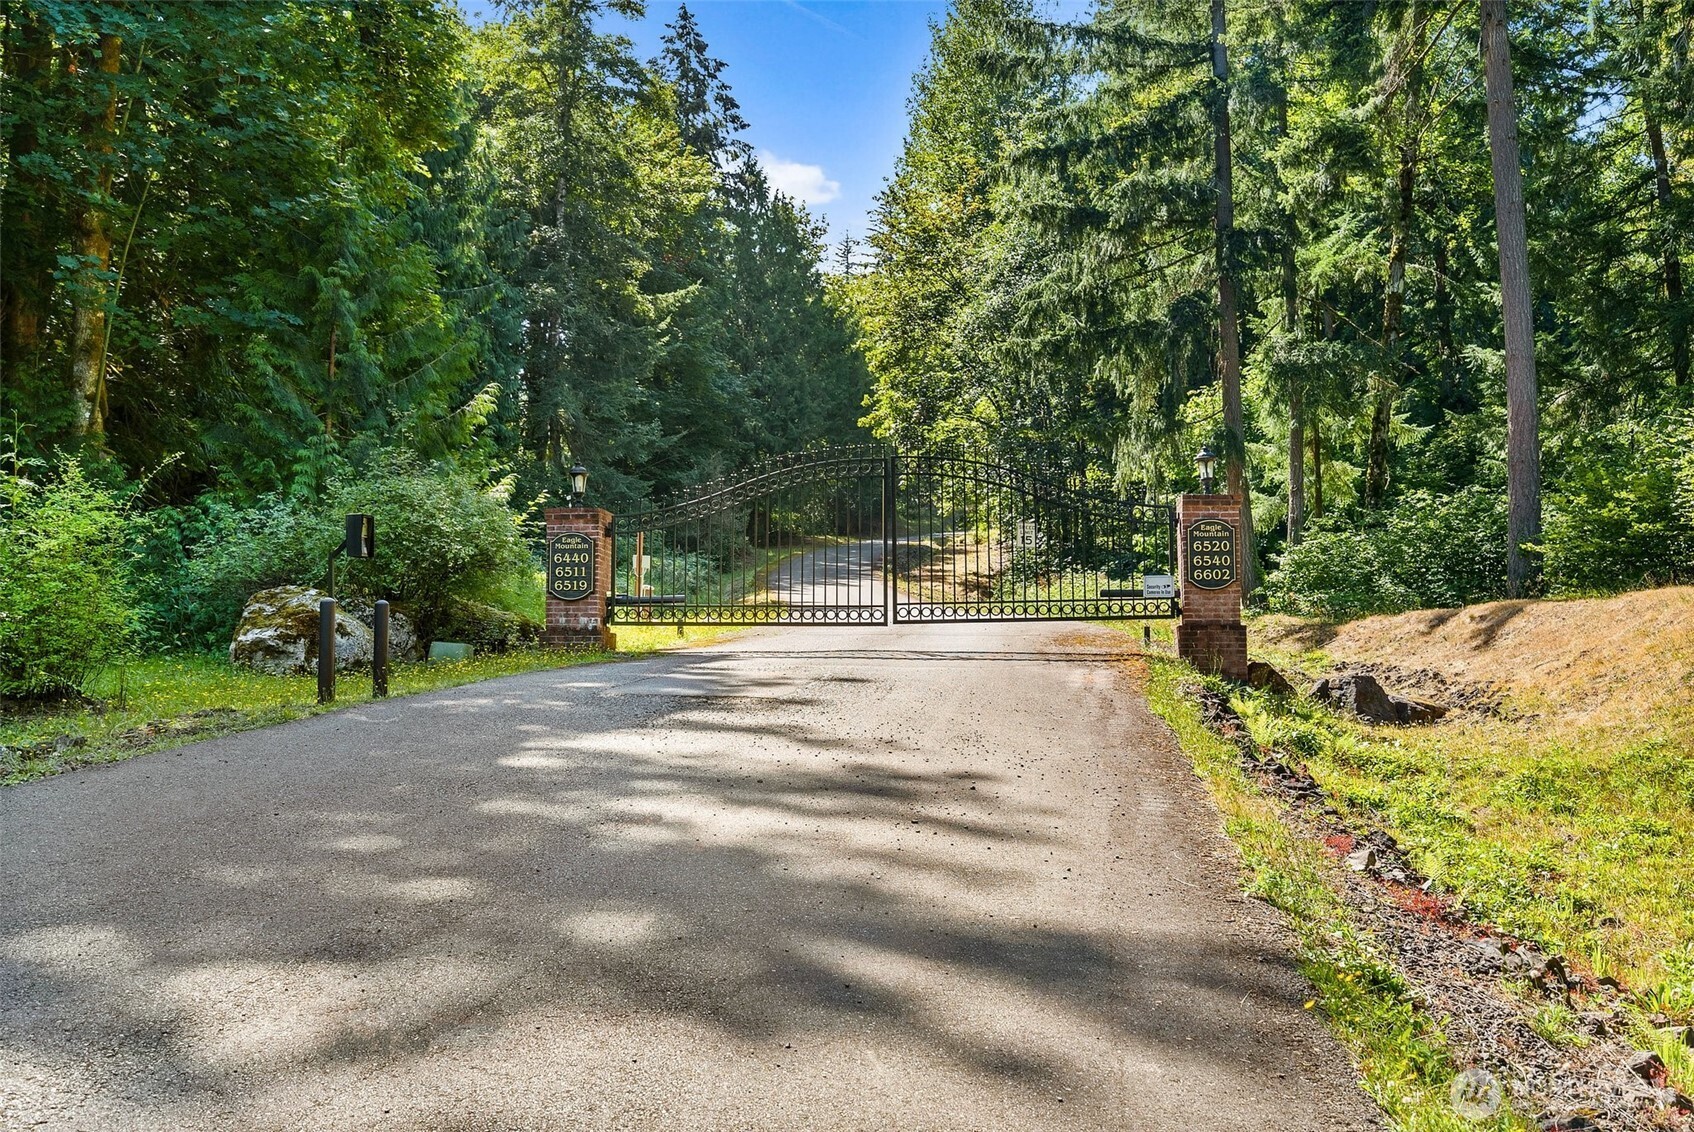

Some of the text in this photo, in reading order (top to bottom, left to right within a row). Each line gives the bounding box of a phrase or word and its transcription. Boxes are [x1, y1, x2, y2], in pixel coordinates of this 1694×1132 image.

[1200, 524, 1222, 532] Eagle
[1193, 540, 1230, 552] 6520
[554, 552, 589, 564] 6440
[1193, 555, 1231, 567] 6540
[555, 566, 587, 577] 6511
[1193, 569, 1231, 580] 6602
[554, 580, 588, 591] 6519
